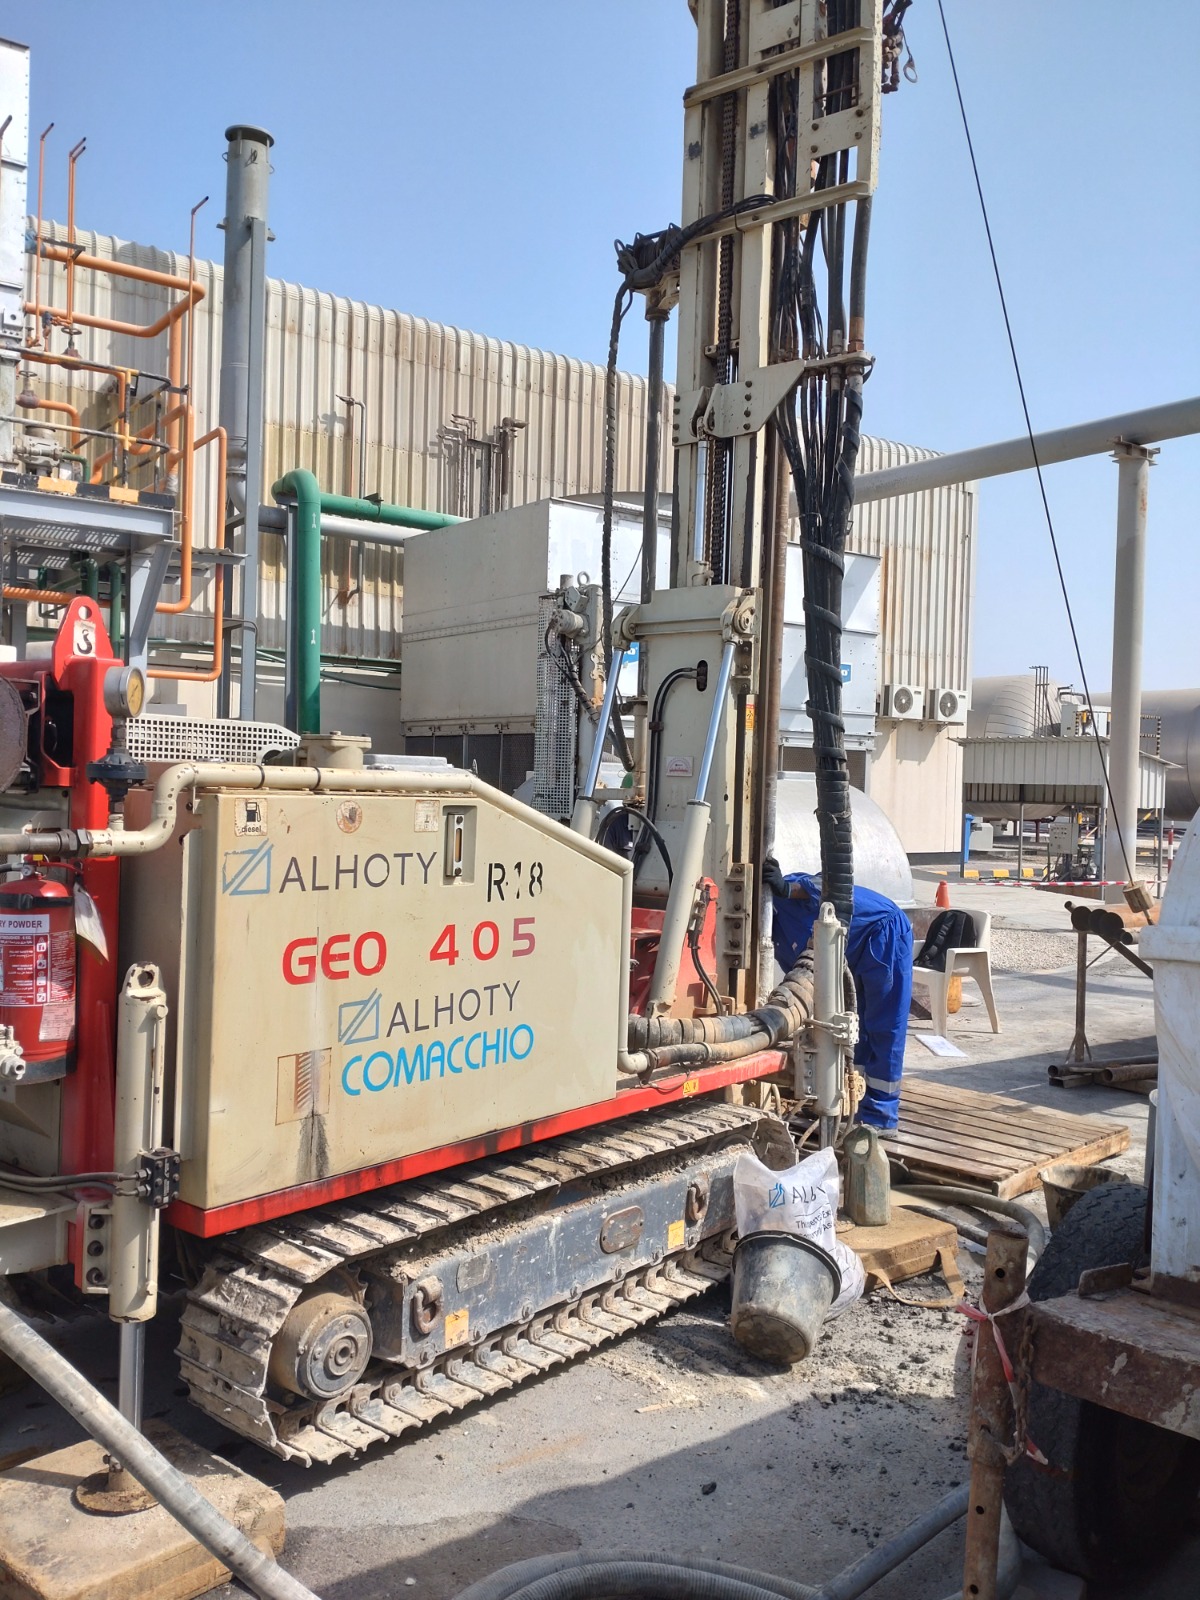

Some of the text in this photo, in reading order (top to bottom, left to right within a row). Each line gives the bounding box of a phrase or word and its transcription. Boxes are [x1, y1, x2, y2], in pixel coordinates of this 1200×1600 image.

[242, 825, 262, 833] diesel
[279, 851, 437, 894] ALHOTY
[8, 920, 43, 929] POWDER
[282, 931, 387, 985] GEO
[386, 980, 521, 1038] ALHOTY
[341, 1023, 535, 1097] COMACCHIO
